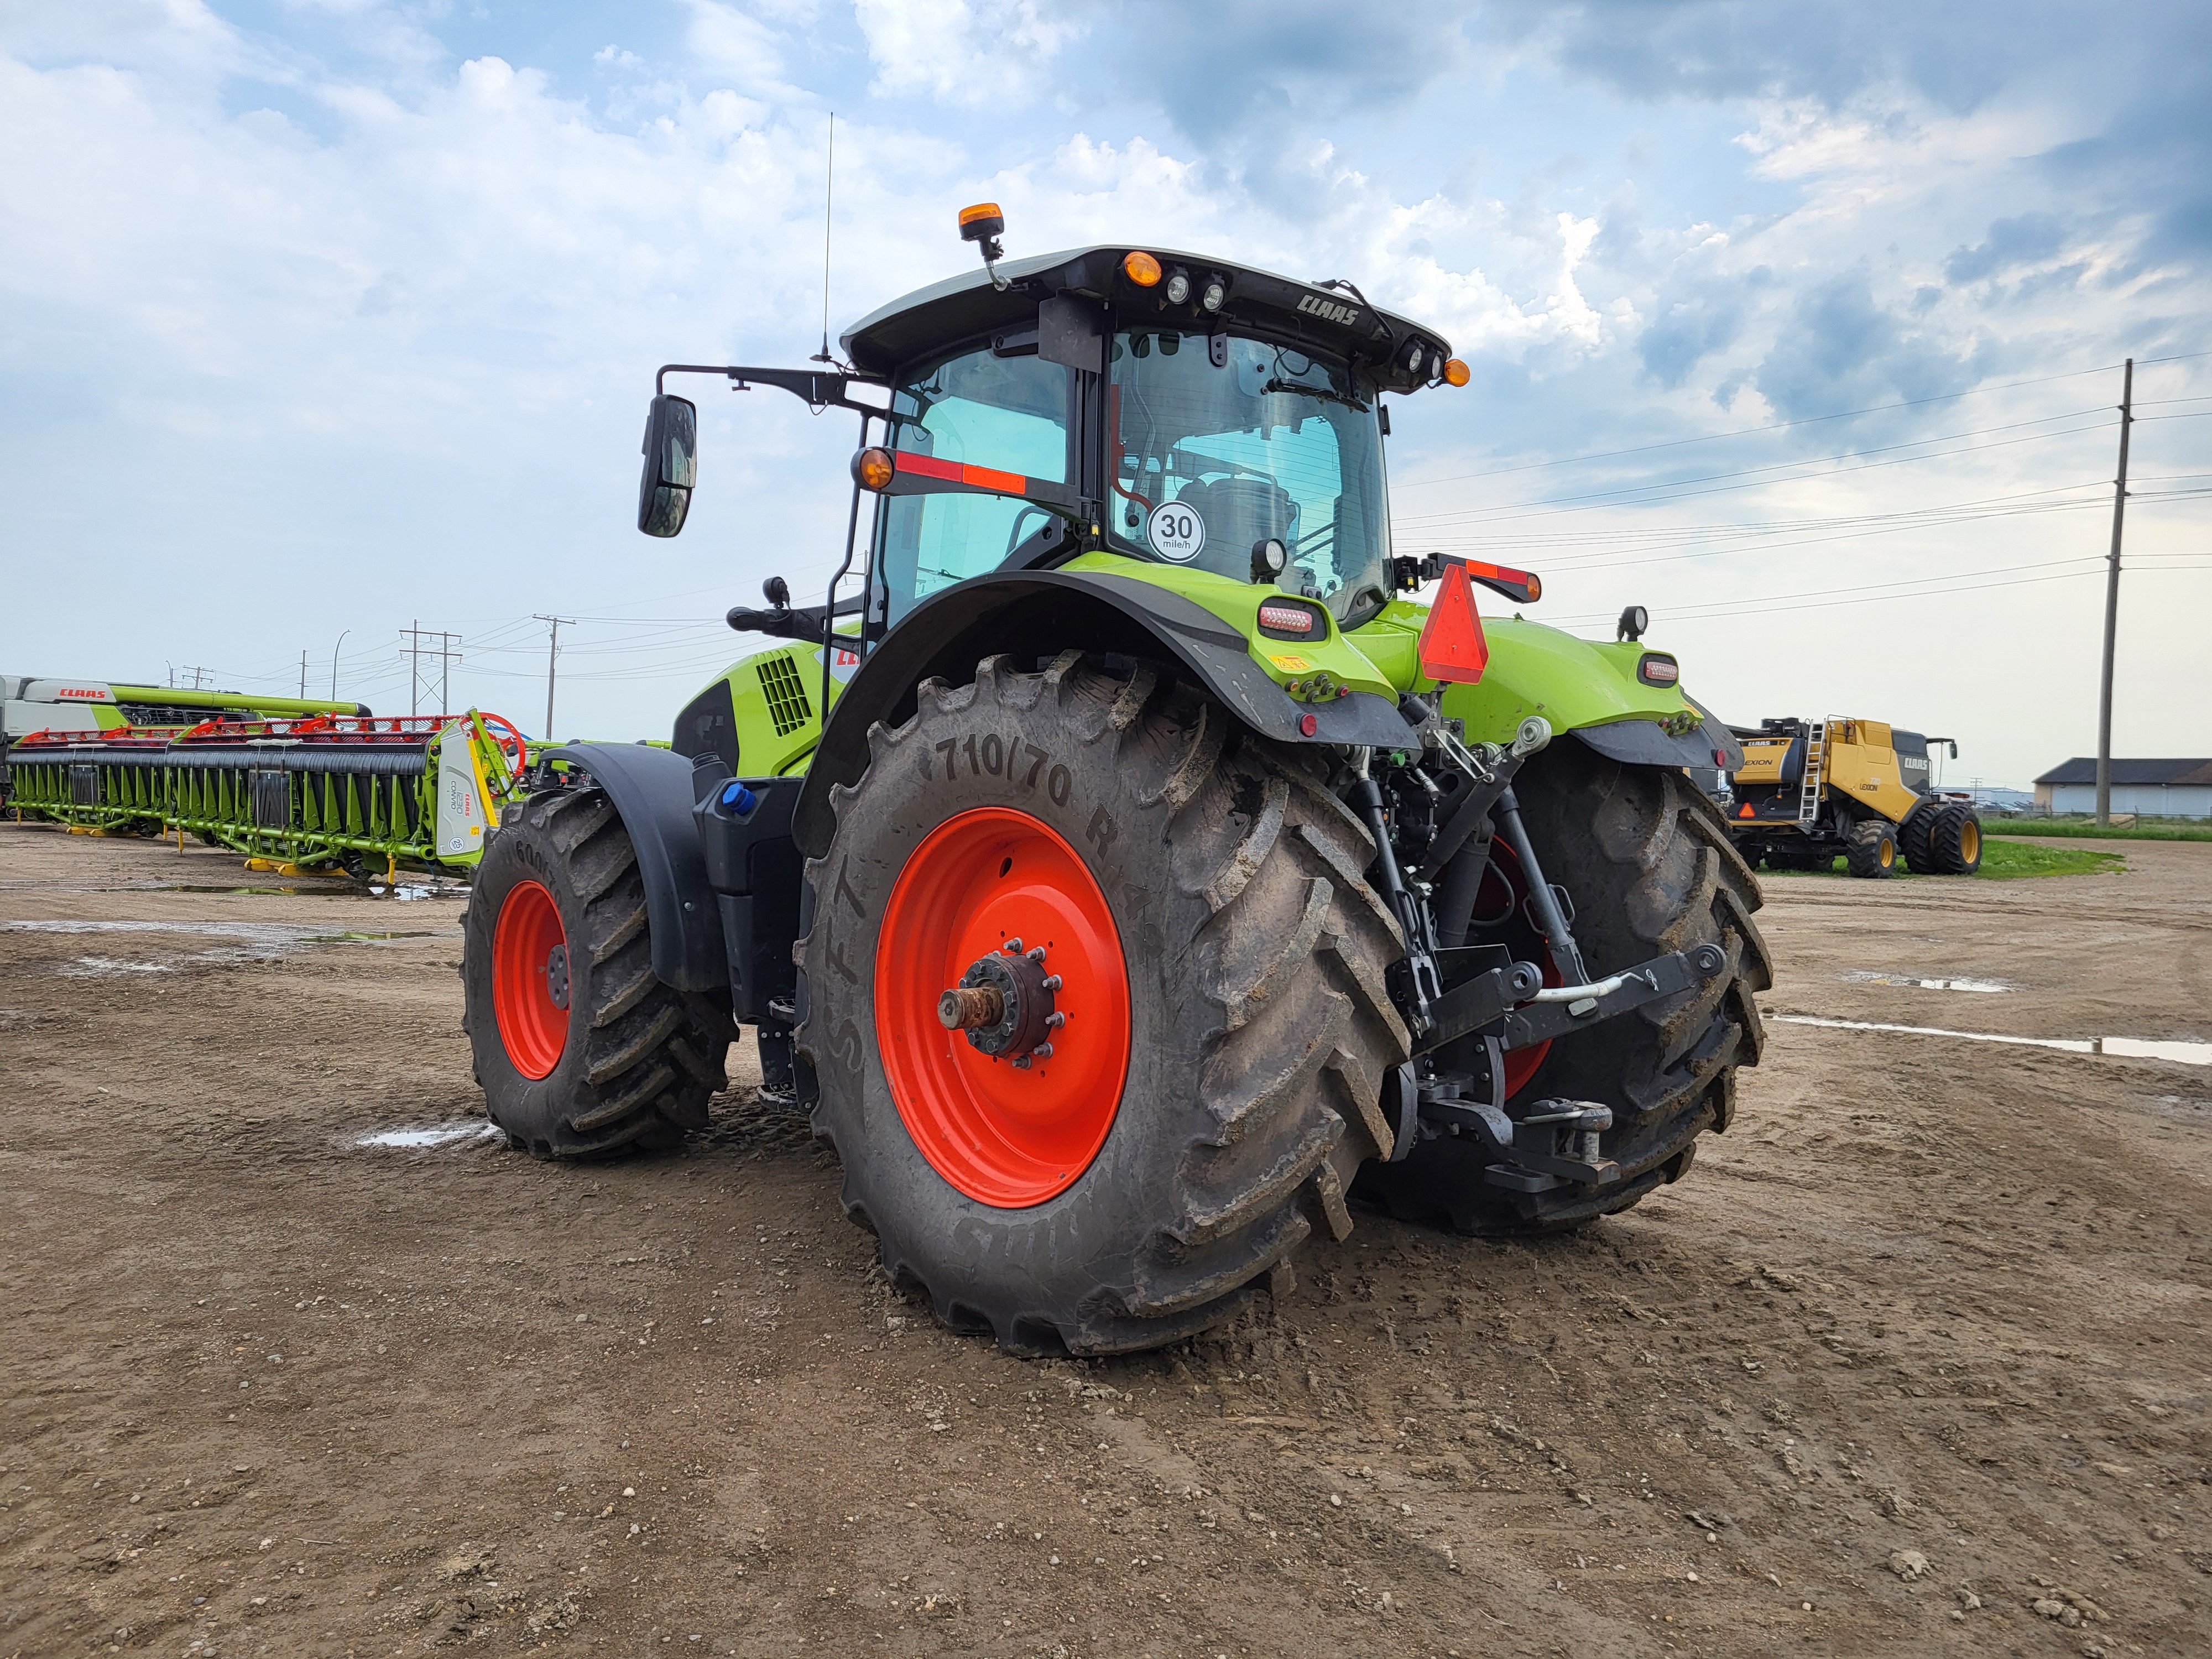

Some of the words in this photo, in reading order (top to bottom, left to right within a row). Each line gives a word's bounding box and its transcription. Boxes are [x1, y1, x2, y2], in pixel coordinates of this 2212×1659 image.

[1296, 294, 1359, 326] CLAAS
[1160, 514, 1193, 539] 30
[1163, 539, 1190, 549] mile/h
[59, 688, 106, 698] CLAAS
[1904, 757, 1928, 770] CLAAS
[935, 733, 1072, 807] 710/70
[1086, 803, 1119, 861] R
[453, 839, 463, 848] 25
